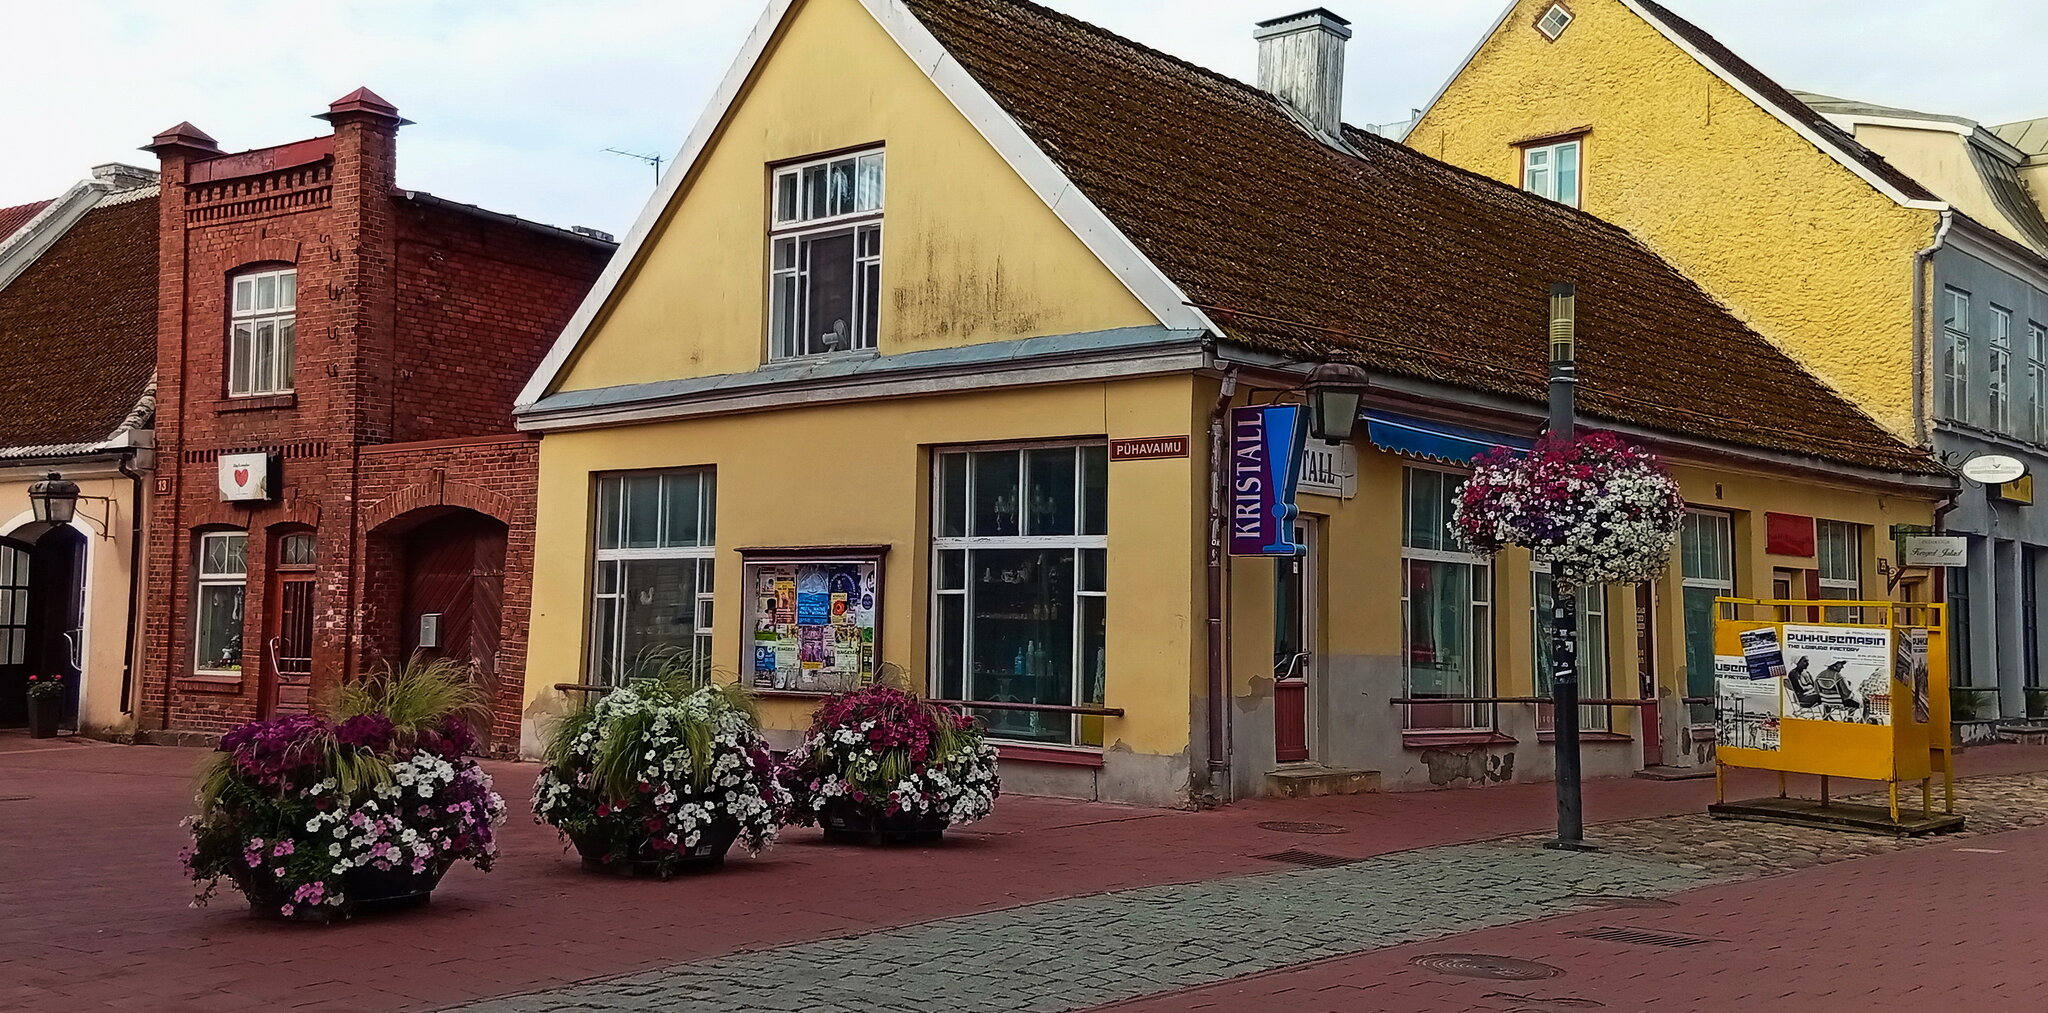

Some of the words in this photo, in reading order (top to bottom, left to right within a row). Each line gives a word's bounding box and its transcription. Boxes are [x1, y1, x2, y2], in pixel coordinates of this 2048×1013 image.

[1116, 441, 1182, 456] PÜHAVAIMU
[1235, 412, 1263, 538] KRISTALL
[158, 480, 167, 491] 13
[1787, 633, 1886, 646] PUHKUSEMASIN
